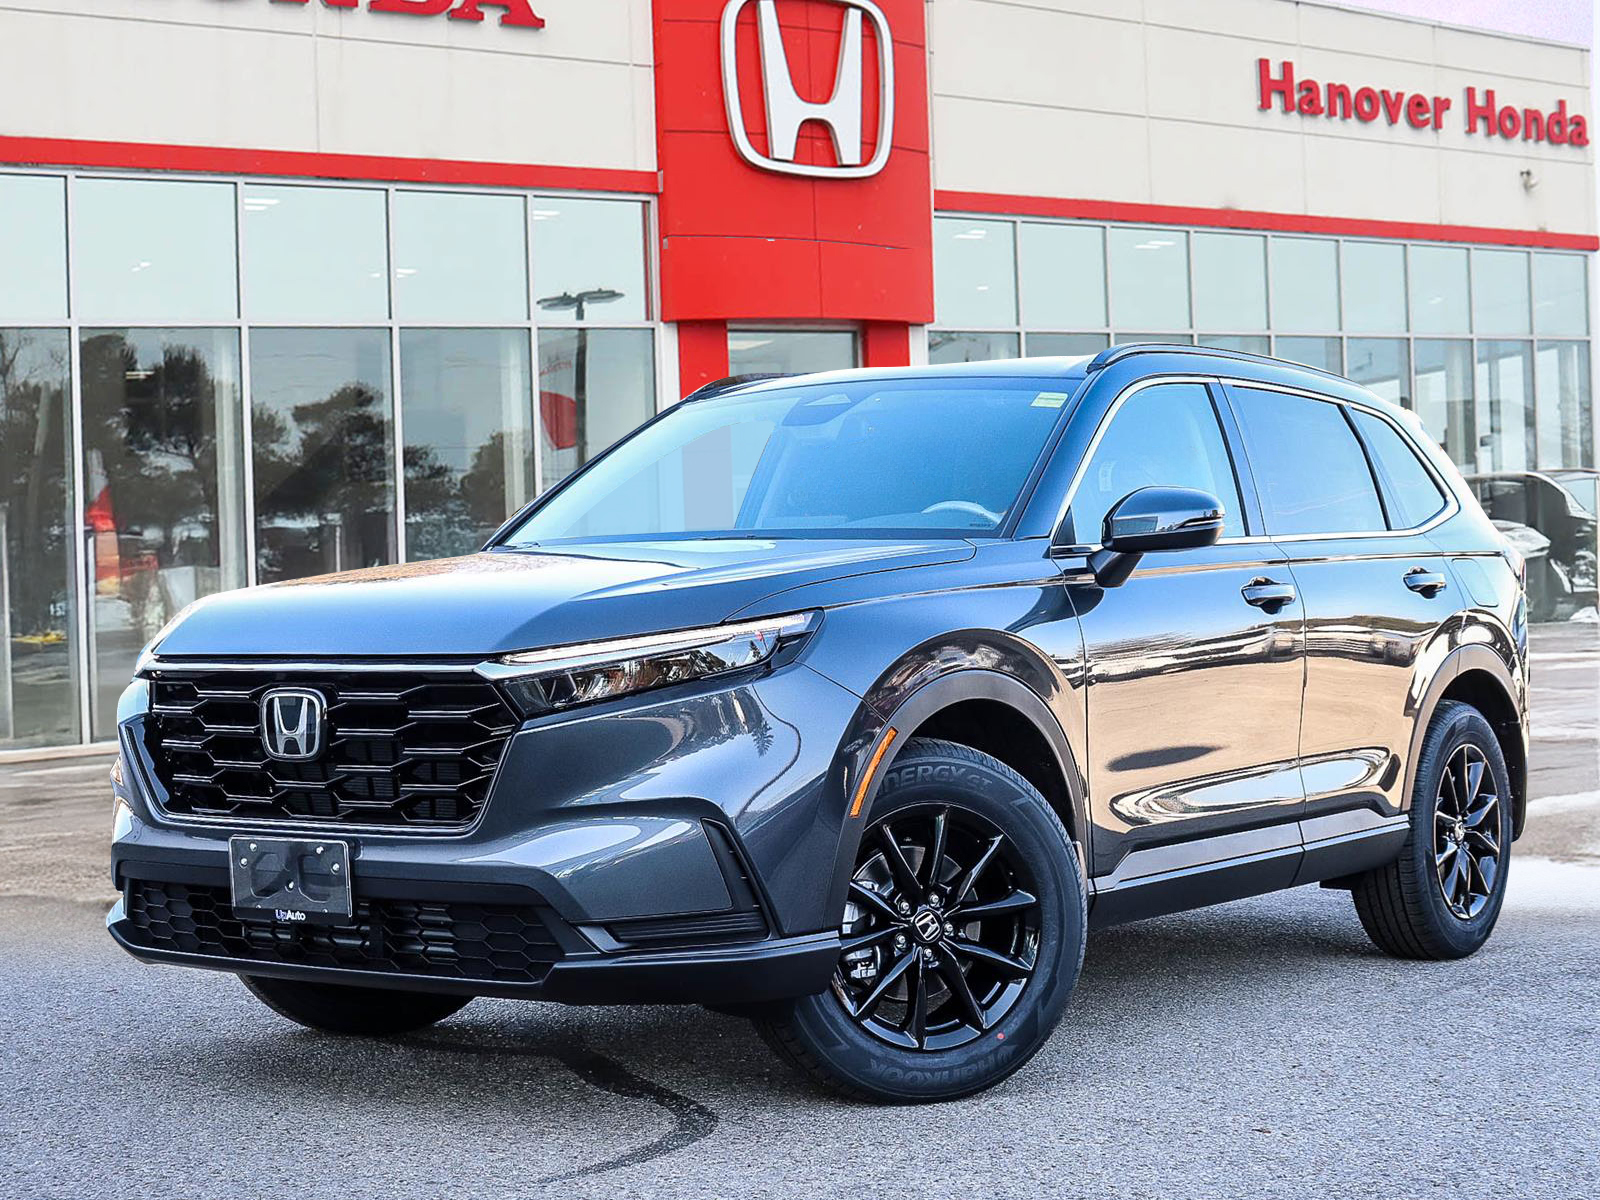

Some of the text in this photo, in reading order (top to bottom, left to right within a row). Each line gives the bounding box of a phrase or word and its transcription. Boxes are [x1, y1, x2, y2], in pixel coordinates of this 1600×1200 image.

[1257, 57, 1590, 147] Hanover Honda
[275, 909, 306, 922] UpAuto
